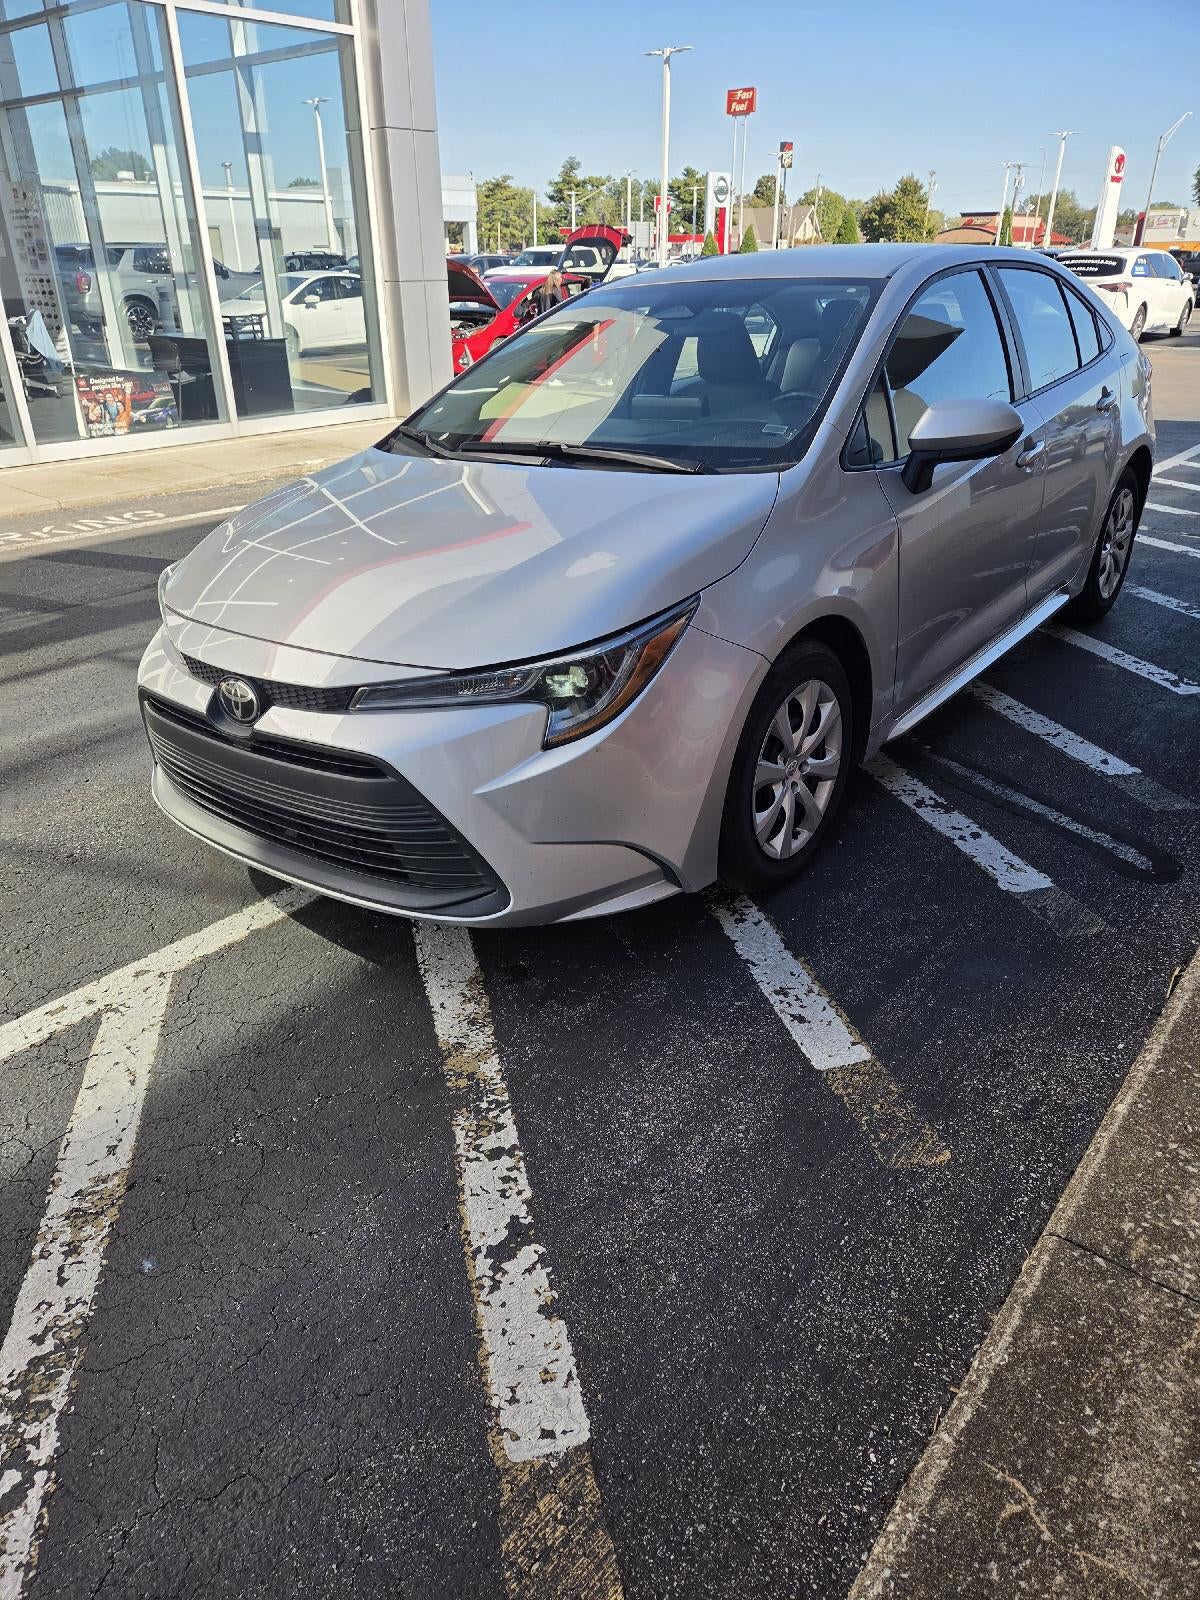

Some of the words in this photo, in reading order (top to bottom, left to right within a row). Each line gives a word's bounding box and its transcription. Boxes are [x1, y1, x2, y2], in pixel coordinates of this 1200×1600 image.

[735, 90, 753, 100] Fast
[731, 101, 748, 112] Fuel
[89, 376, 115, 385] Designed
[91, 383, 111, 391] people
